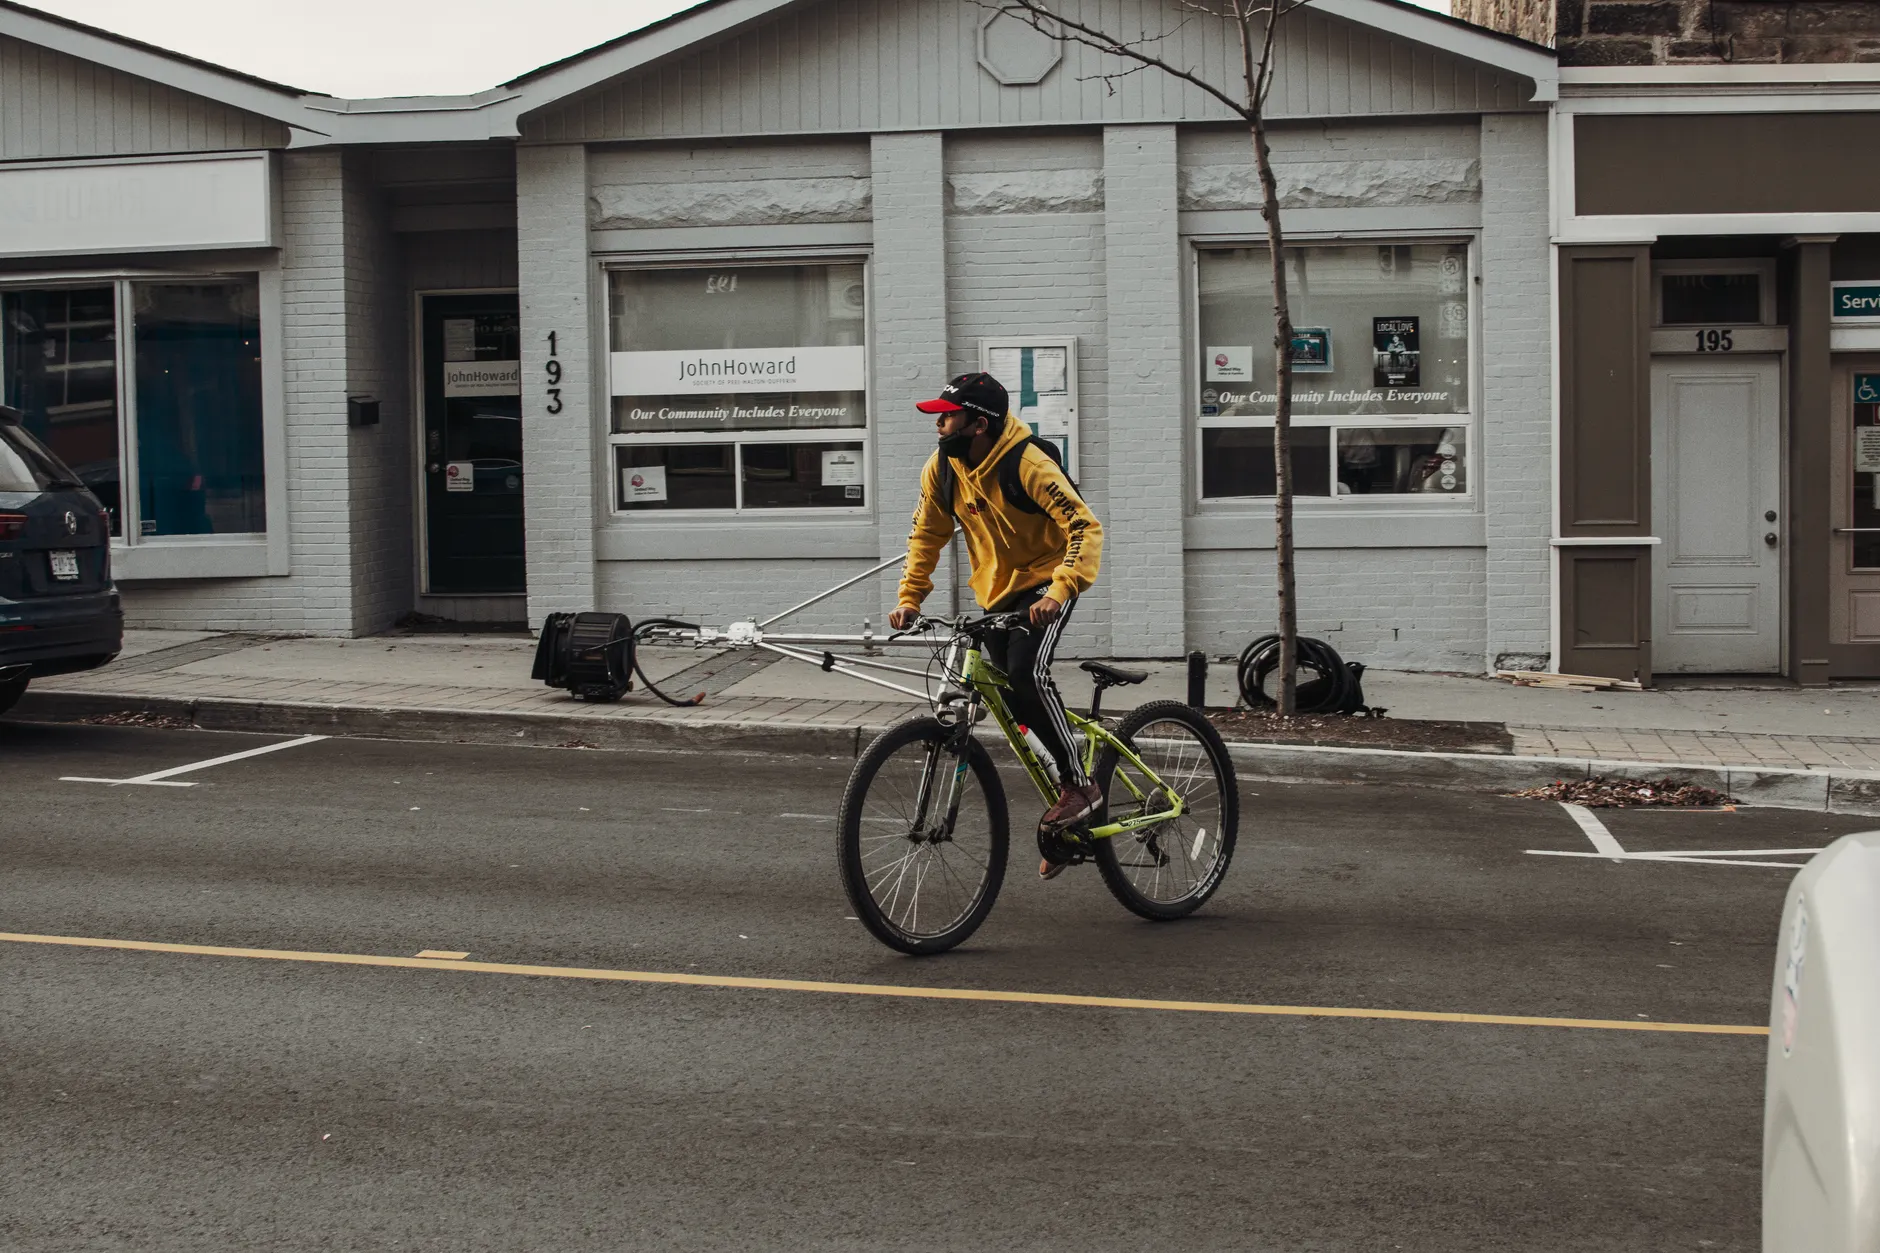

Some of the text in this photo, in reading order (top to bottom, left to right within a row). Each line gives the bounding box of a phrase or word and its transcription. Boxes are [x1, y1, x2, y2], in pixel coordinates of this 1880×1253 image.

[1842, 294, 1880, 309] Servi
[1377, 322, 1414, 332] LOCAL LOVE
[1695, 329, 1733, 352] 195
[447, 368, 518, 385] JohnHoward
[545, 330, 563, 414] 193
[679, 356, 796, 381] JohnHoward
[1219, 389, 1449, 405] Our Comunity Includes Everyone
[630, 405, 847, 421] Our Community Includes Everyone
